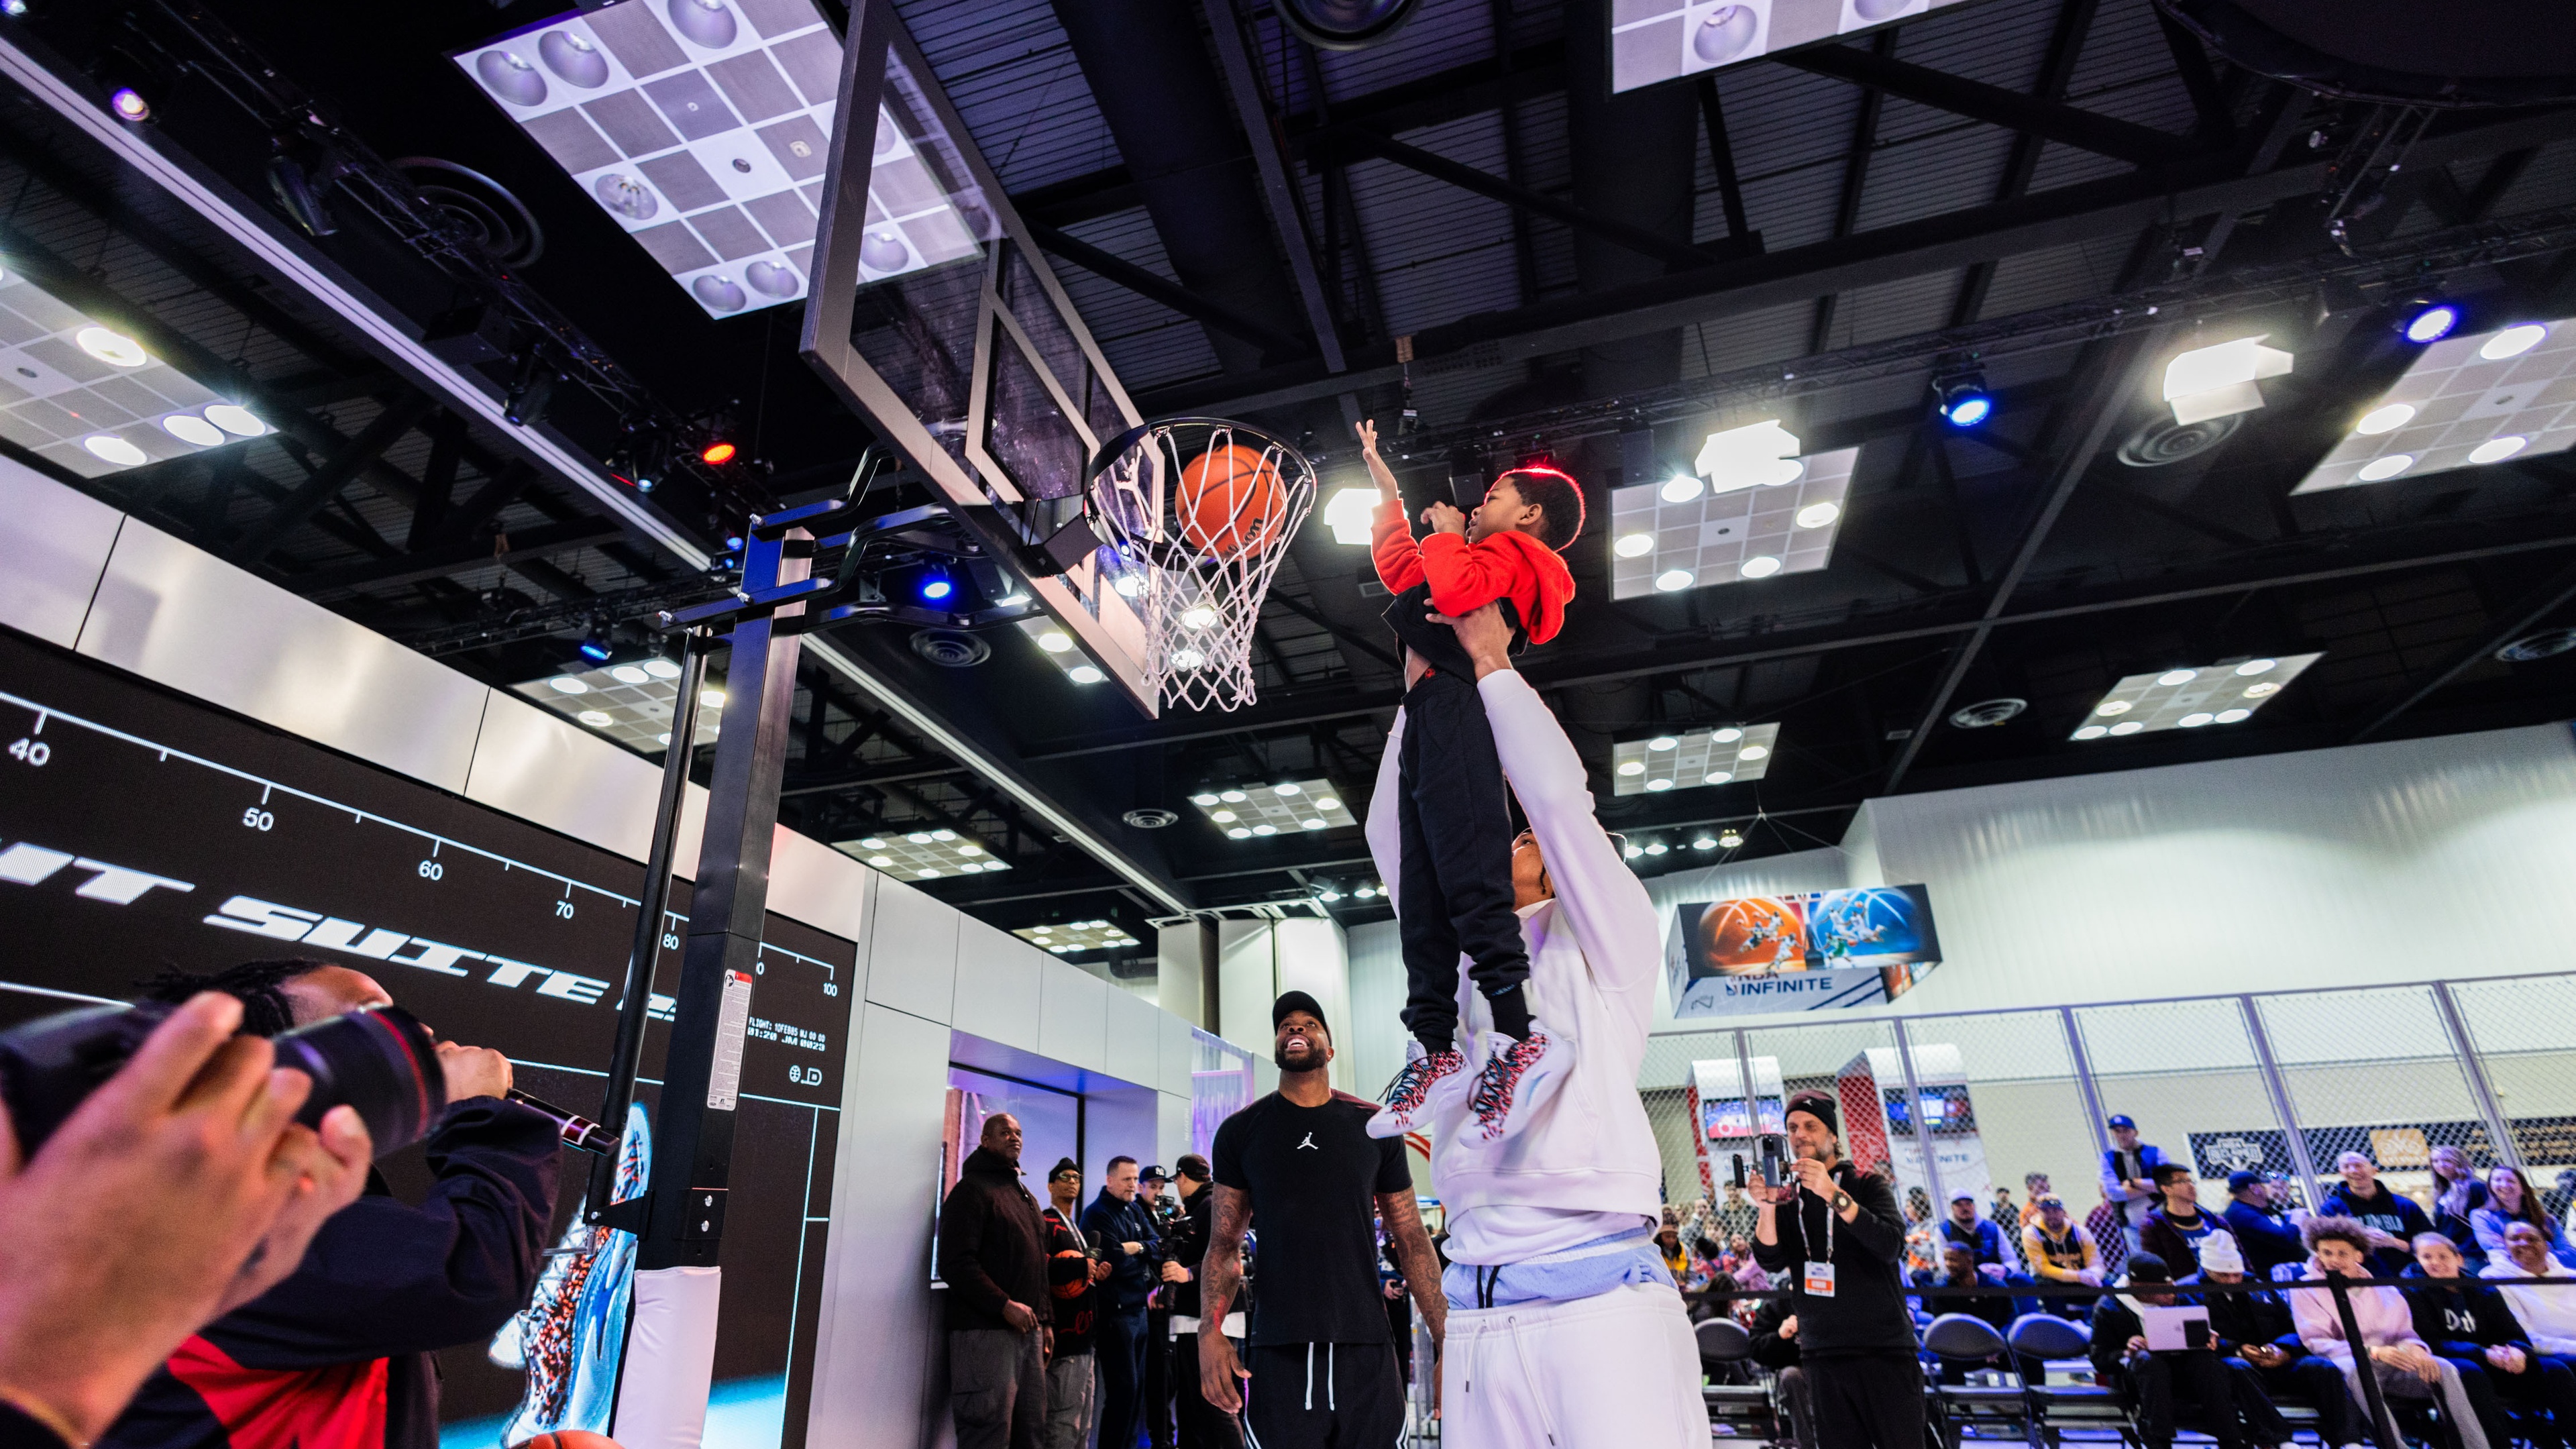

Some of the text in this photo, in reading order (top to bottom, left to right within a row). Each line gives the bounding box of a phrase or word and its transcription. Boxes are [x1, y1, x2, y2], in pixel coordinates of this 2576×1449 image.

[9, 739, 51, 766] 40
[243, 807, 274, 831] 50
[418, 860, 443, 880] 60
[555, 901, 574, 919] 70
[661, 932, 680, 950] 80
[823, 983, 838, 997] 100
[203, 895, 610, 1005] SUITE
[1741, 977, 1833, 996] INFINITE
